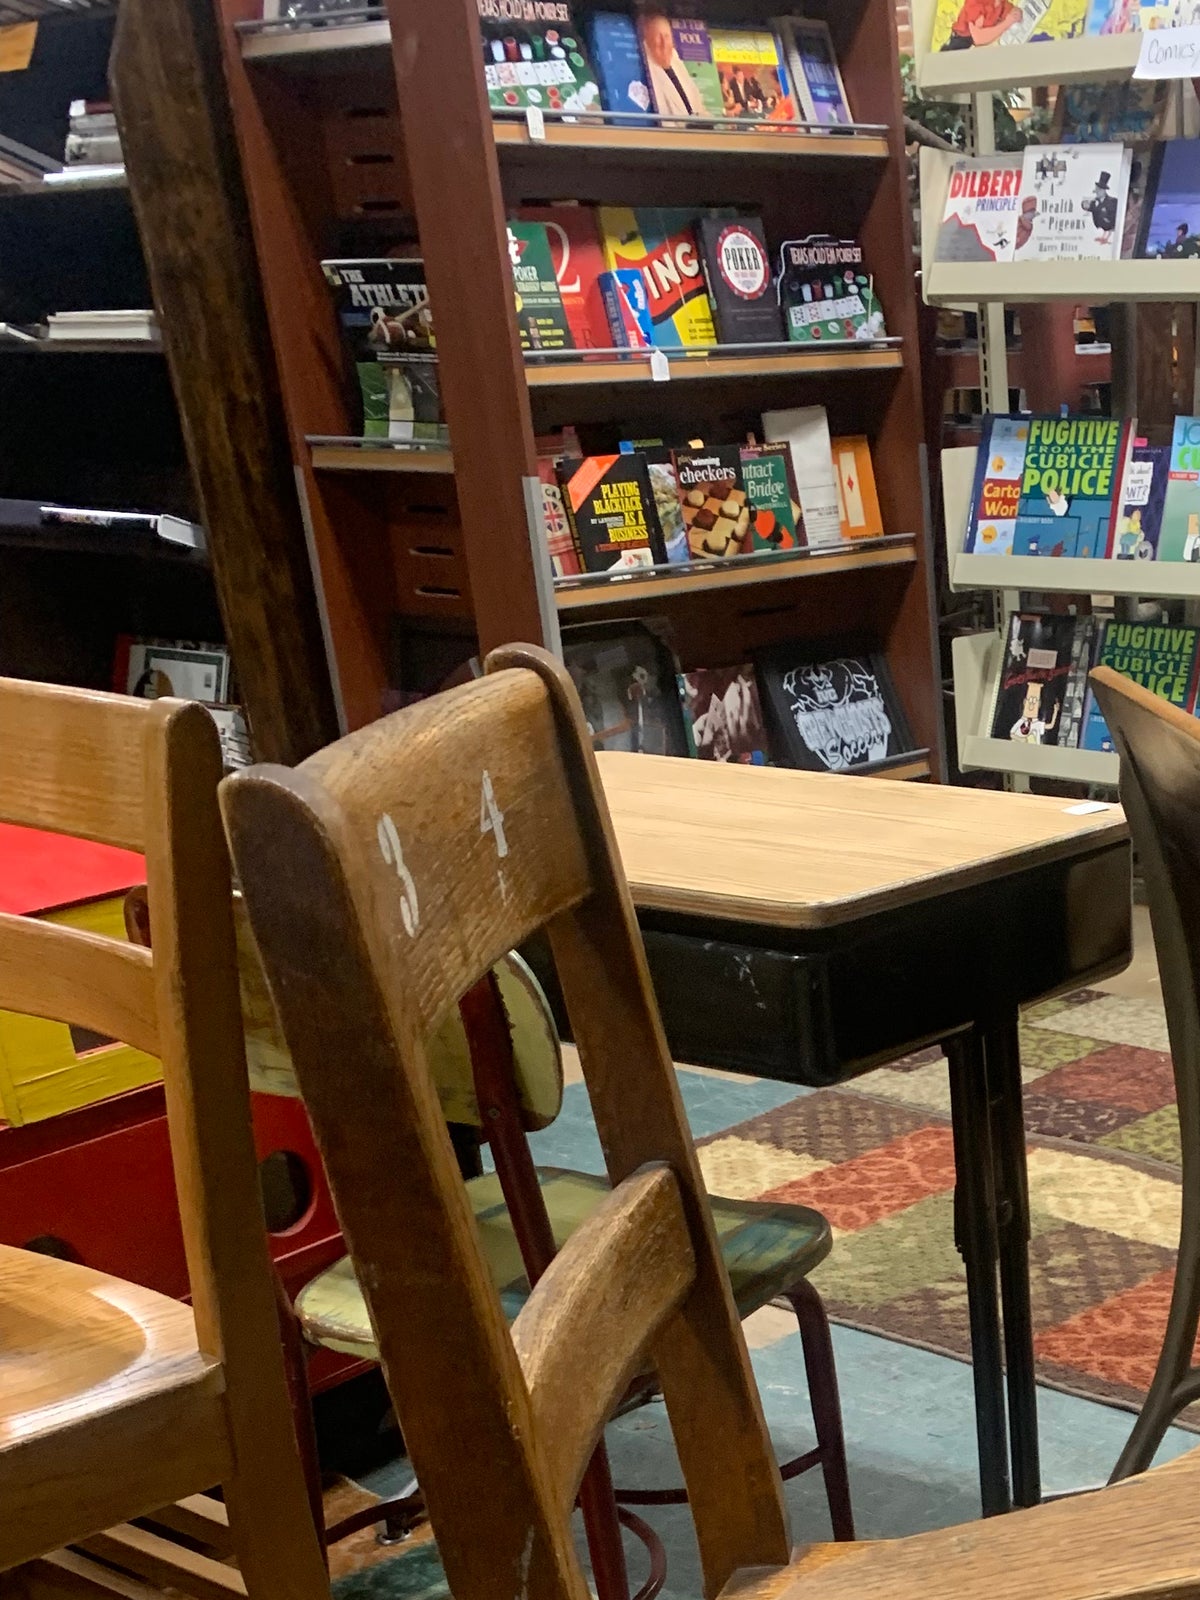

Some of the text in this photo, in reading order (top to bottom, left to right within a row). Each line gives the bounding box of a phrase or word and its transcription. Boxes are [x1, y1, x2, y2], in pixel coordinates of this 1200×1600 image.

[679, 33, 704, 45] POOL
[976, 197, 1018, 213] PRINCIPLE
[1041, 199, 1074, 214] Wealth
[1048, 215, 1086, 235] Pigeons
[724, 247, 762, 271] POKER
[340, 269, 366, 283] THE
[513, 266, 539, 281] POKER
[1029, 419, 1120, 446] FUGITIVE
[763, 443, 787, 451] Series
[1028, 446, 1116, 454] FROM THE
[741, 461, 775, 479] ntract
[1025, 454, 1114, 470] CUBICLE
[680, 465, 737, 484] checkers
[1022, 468, 1112, 496] POLICE
[601, 481, 640, 498] PLAYING
[747, 478, 785, 502] Bridge
[983, 483, 1021, 499] Carto
[593, 496, 643, 515] BLACKJACK
[624, 511, 636, 526] AS
[638, 510, 646, 524] A
[608, 525, 649, 543] BUSINESS
[1105, 624, 1196, 654] FUGITIVE
[1103, 647, 1192, 662] FROM THE
[1101, 655, 1191, 677] CUBICLE
[825, 728, 883, 768] Soccer
[376, 812, 420, 938] 3
